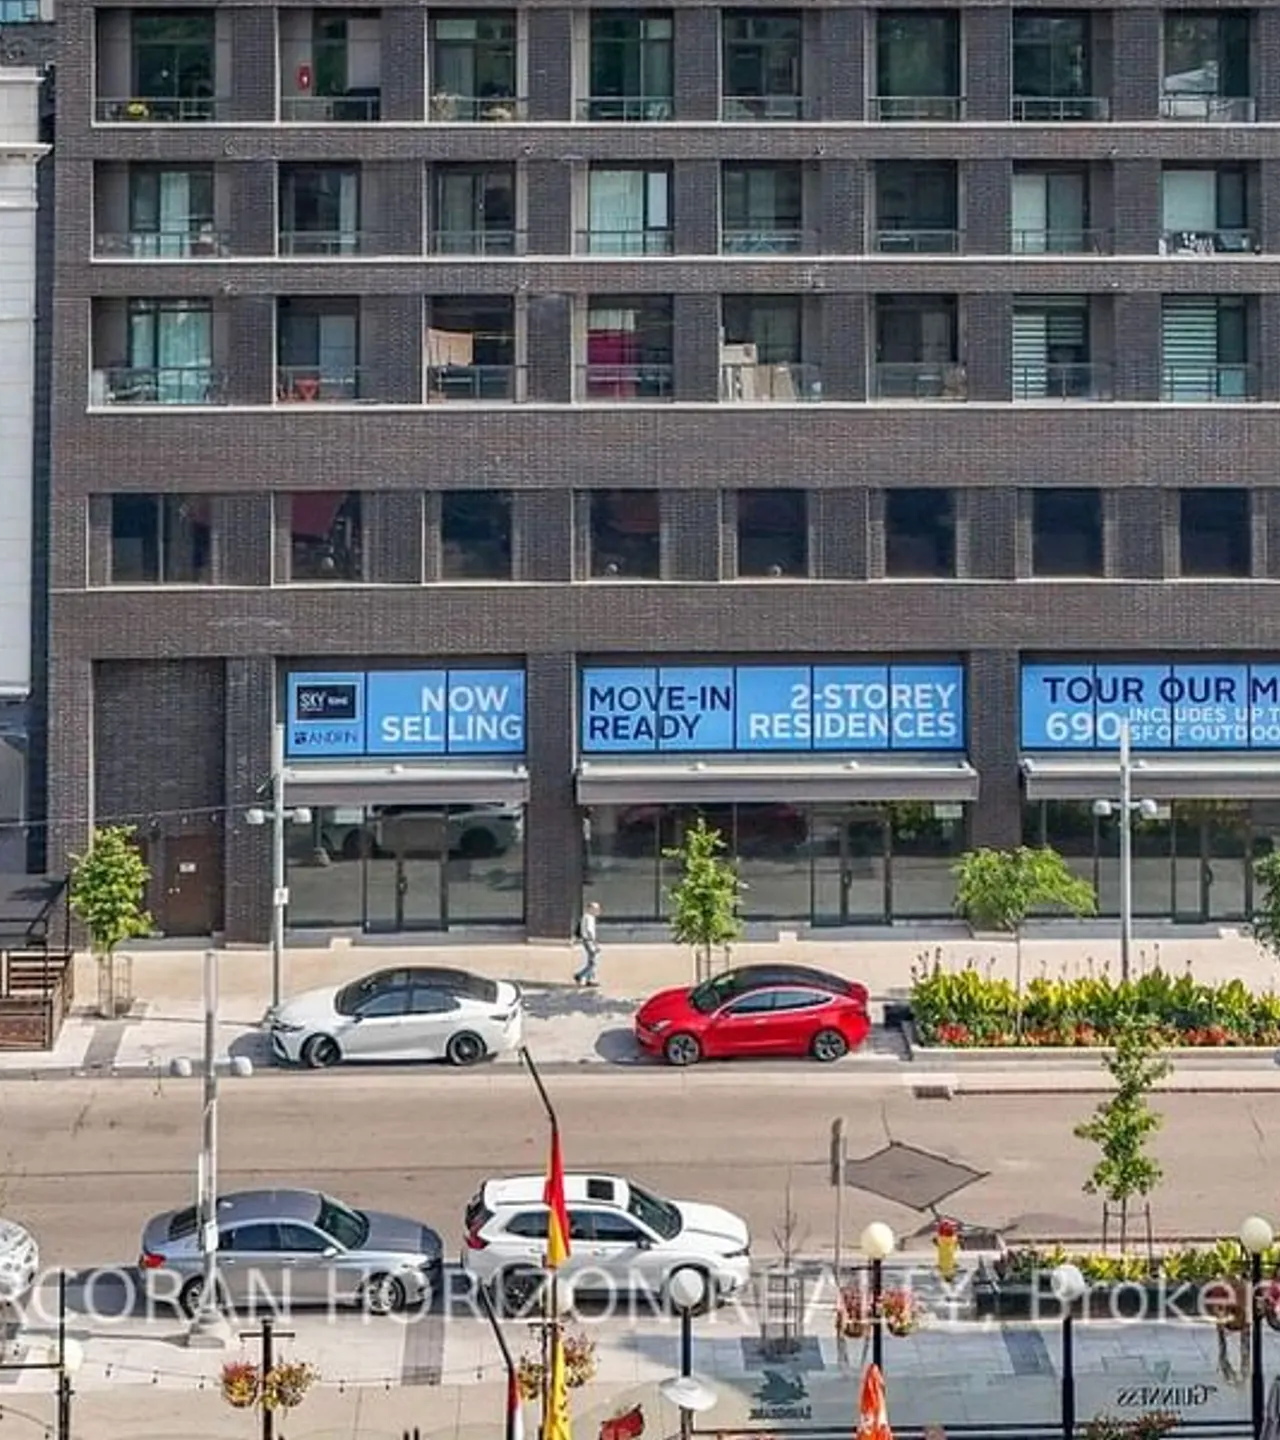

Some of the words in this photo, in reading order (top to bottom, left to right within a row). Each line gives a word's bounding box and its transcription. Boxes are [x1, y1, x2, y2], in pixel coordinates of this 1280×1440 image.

[421, 685, 509, 713] NOW
[589, 685, 731, 712] MOVE-IN
[791, 683, 956, 710] 2-STOREY
[1043, 676, 1144, 703] TOUR
[1159, 676, 1237, 703] OUR
[381, 714, 523, 742] SELLING
[589, 714, 703, 741] READY
[750, 712, 956, 739] RESIDENCES
[1044, 712, 1122, 742] 690
[1129, 707, 1226, 724] INCLUDES
[1235, 707, 1263, 723] UP
[1130, 724, 1154, 741] SF
[1156, 724, 1185, 741] OF
